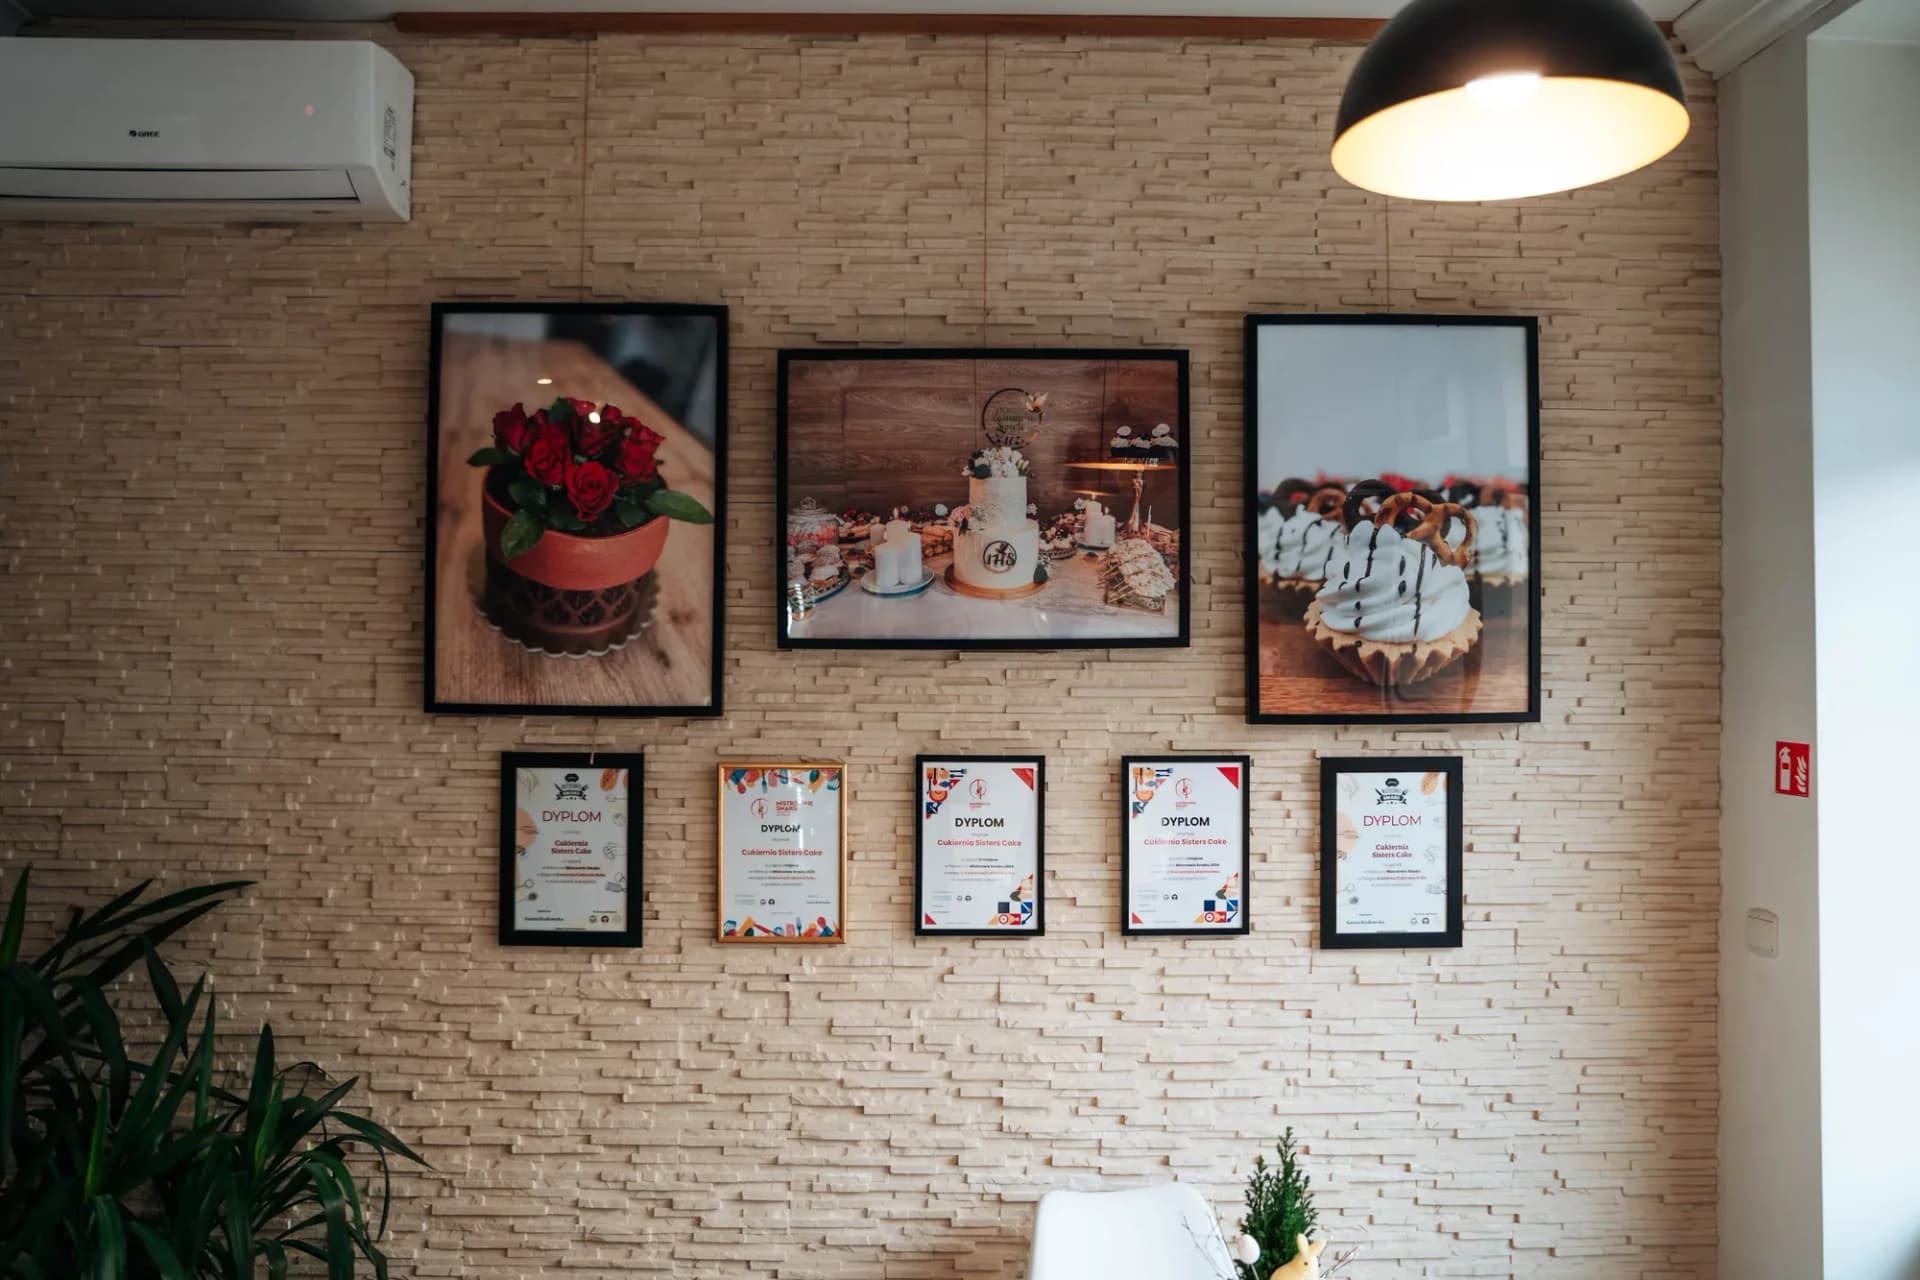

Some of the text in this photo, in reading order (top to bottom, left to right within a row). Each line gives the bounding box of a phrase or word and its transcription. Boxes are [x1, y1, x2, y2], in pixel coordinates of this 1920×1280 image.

[542, 810, 601, 823] DYPLOM
[1161, 817, 1210, 827] DYPLOM
[1363, 815, 1421, 827] DYPLOM
[955, 818, 1004, 827] DYPLOM
